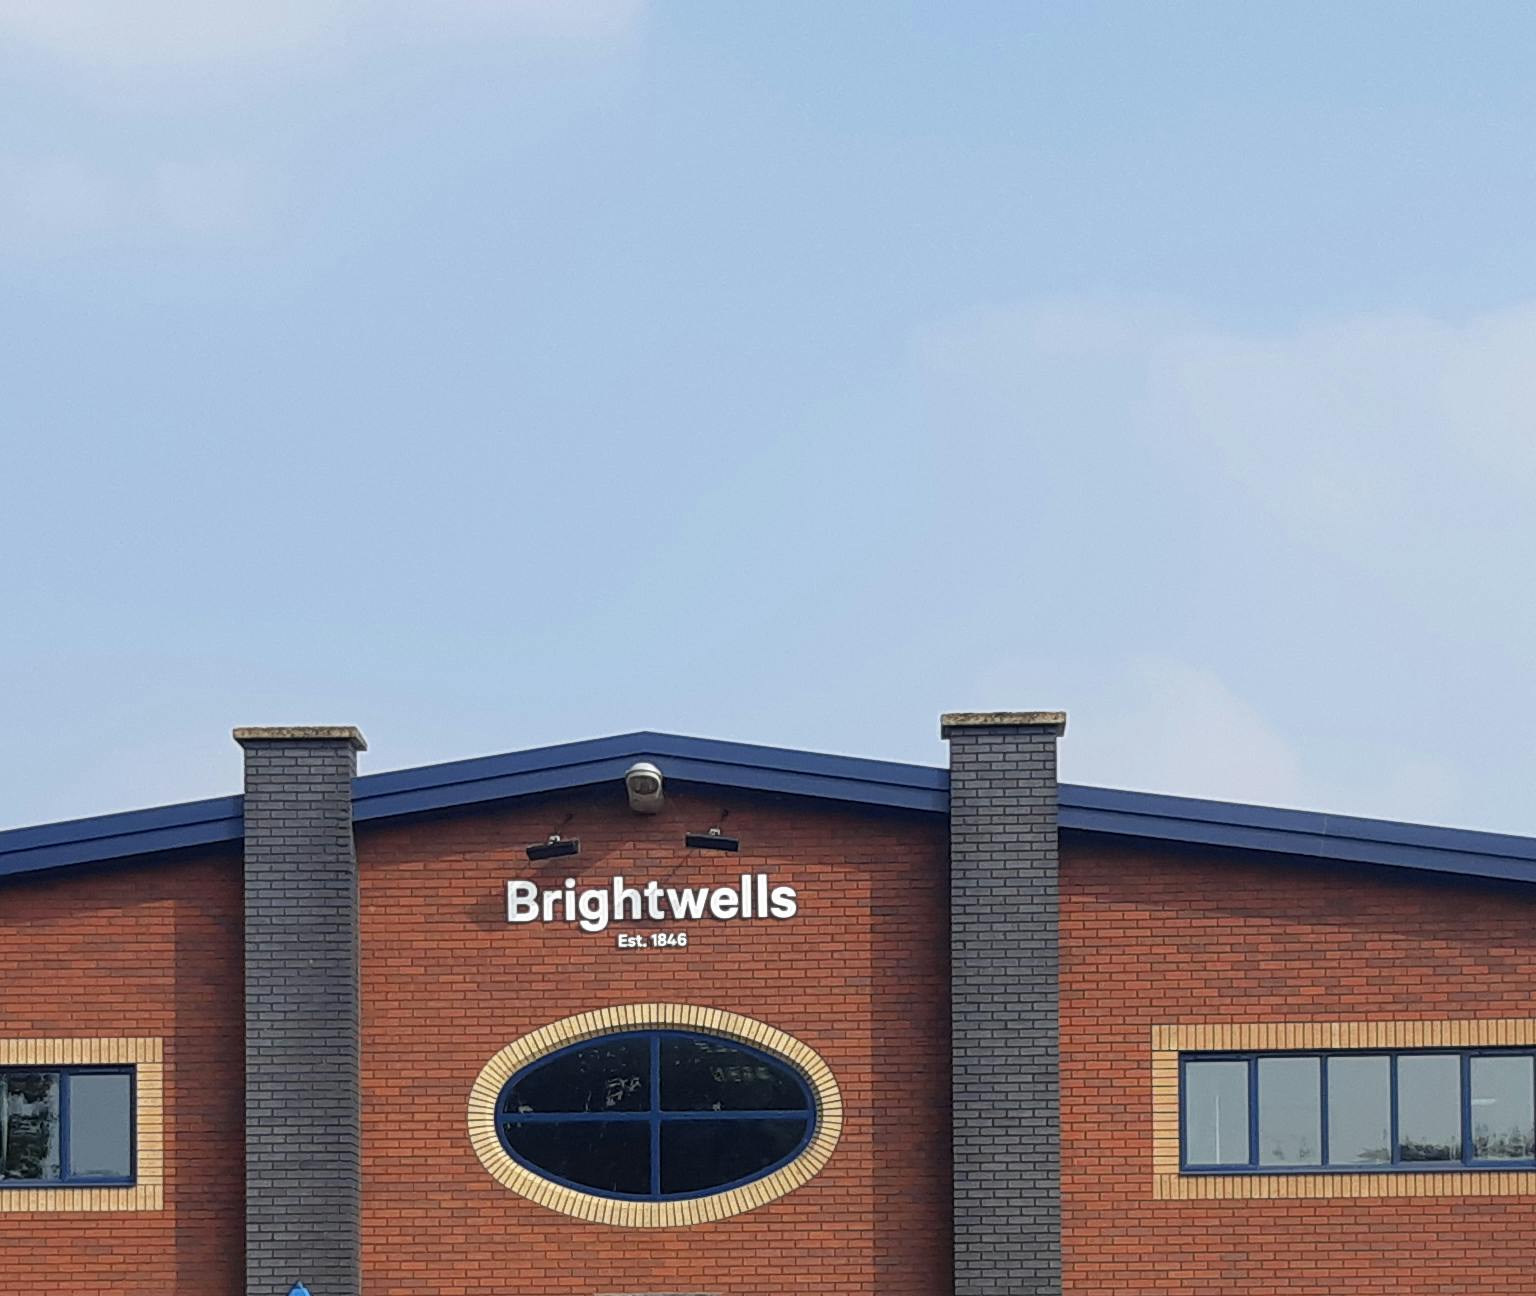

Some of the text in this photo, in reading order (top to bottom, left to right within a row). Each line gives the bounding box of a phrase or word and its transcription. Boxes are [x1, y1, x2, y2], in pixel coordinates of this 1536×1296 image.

[507, 873, 798, 932] Brightwells
[618, 932, 688, 948] Est. 1846
